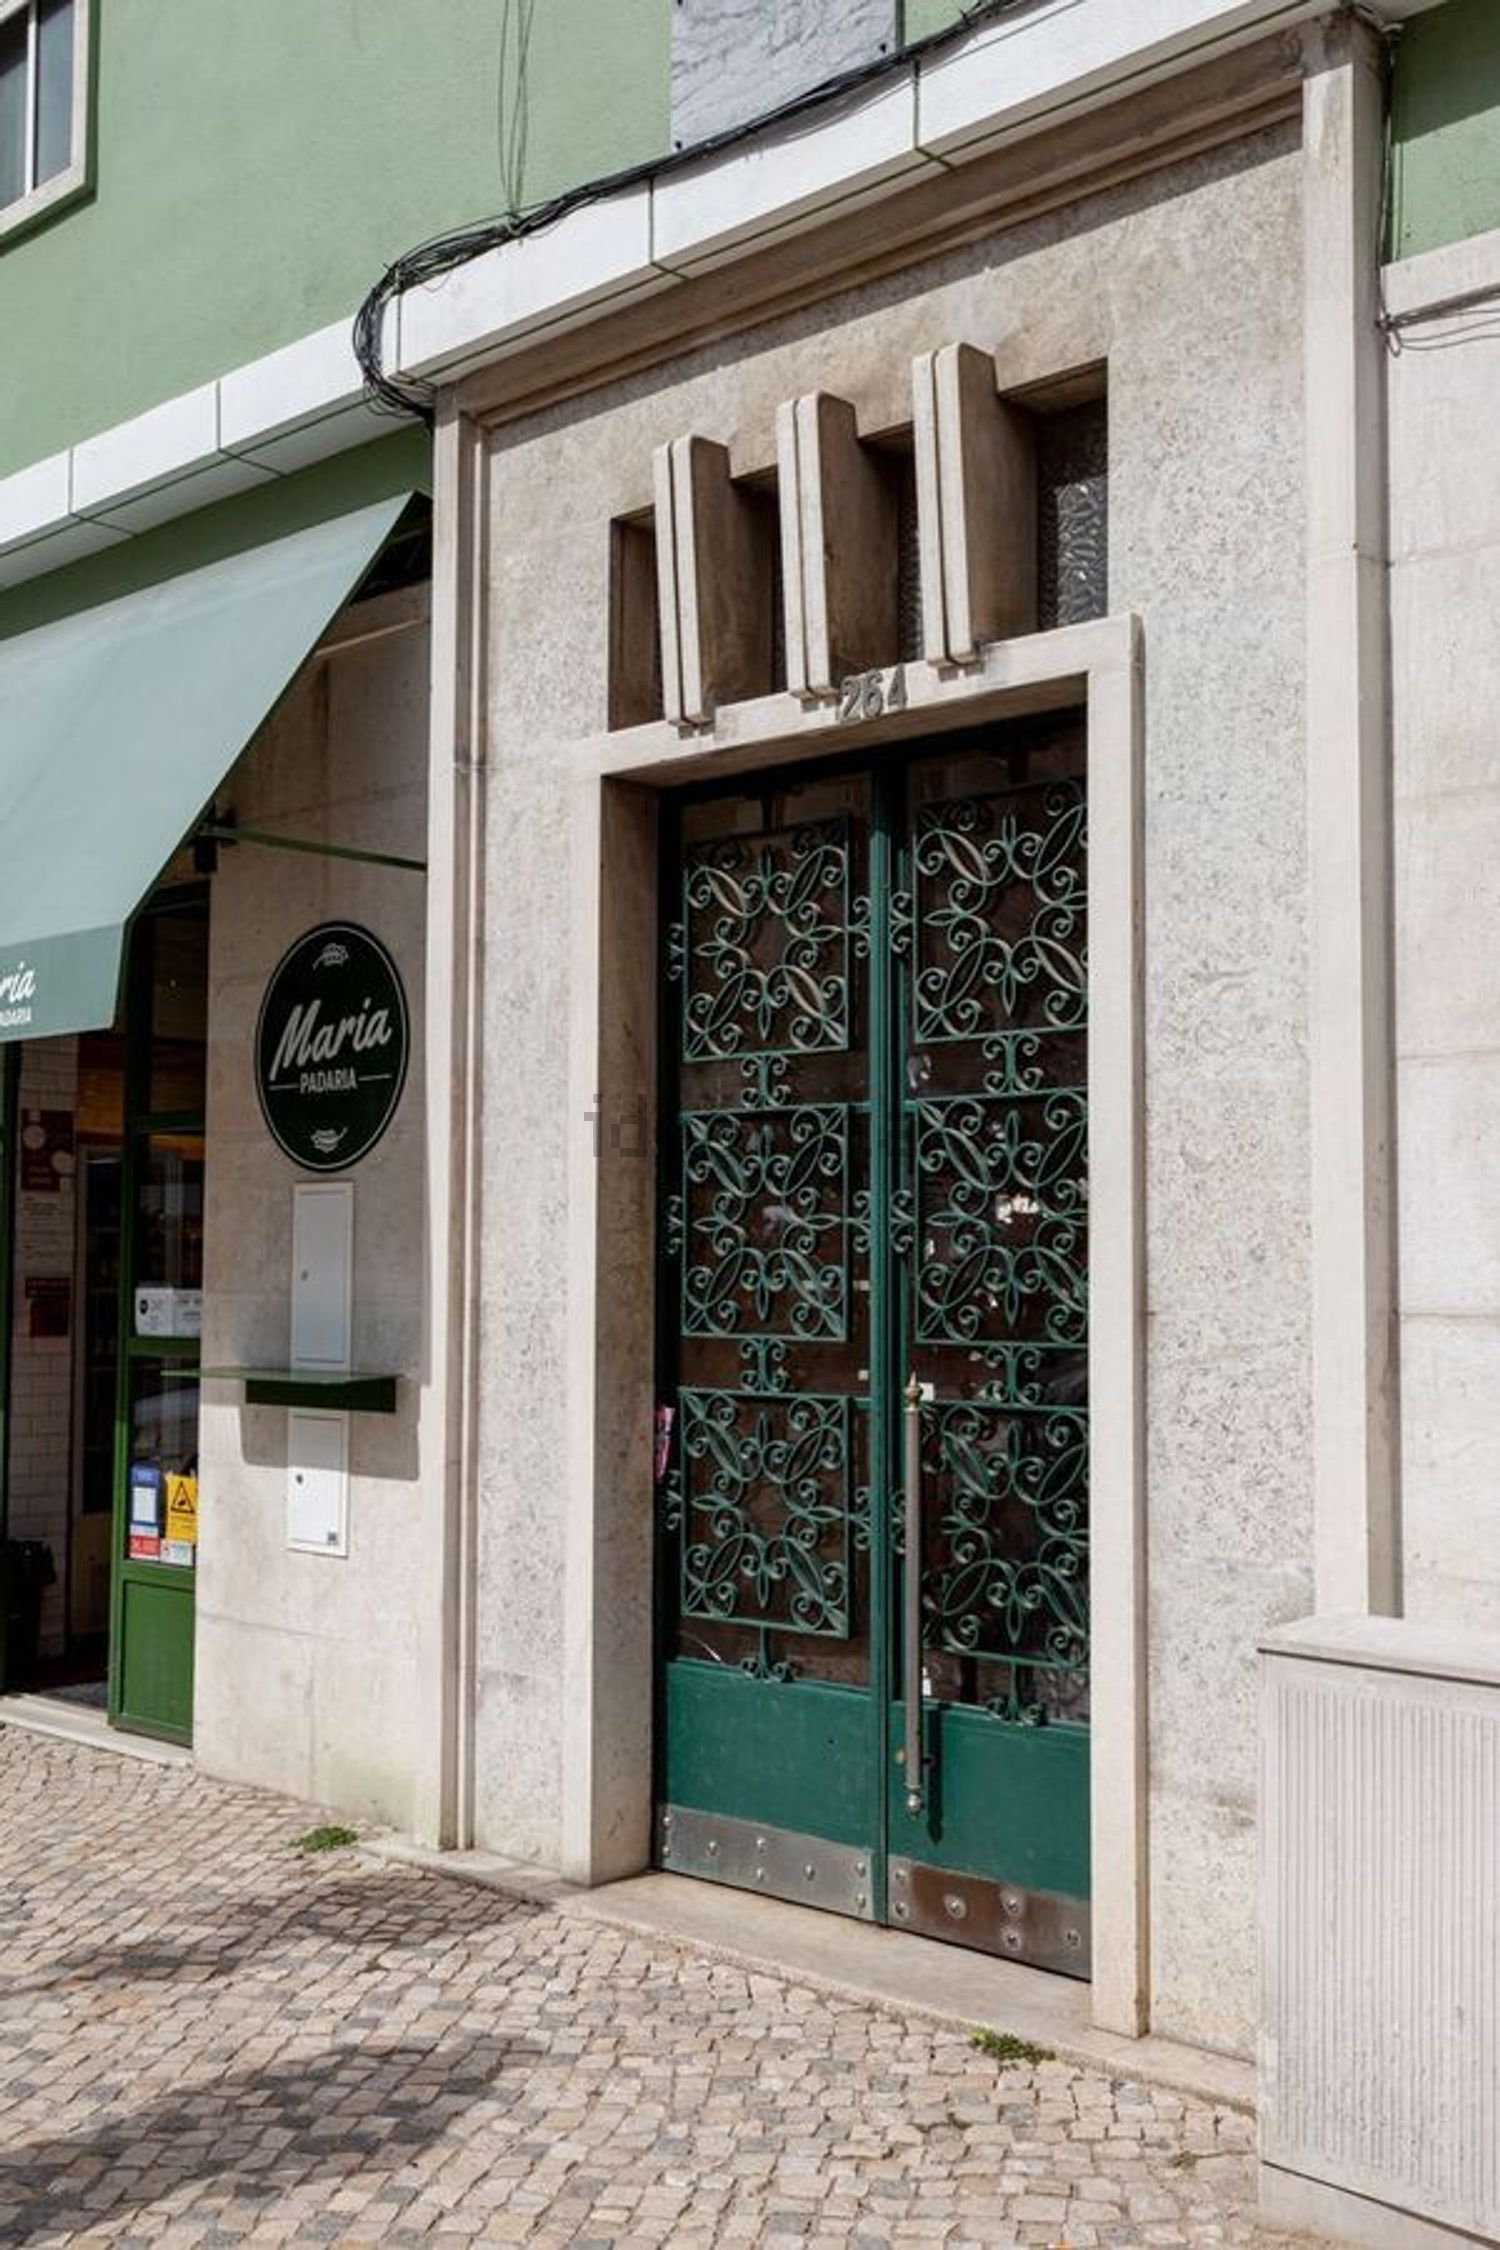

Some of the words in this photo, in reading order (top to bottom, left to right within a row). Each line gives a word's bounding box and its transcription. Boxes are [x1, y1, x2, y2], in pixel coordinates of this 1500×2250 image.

[839, 665, 908, 726] 264
[269, 997, 393, 1082] Maria
[300, 1067, 358, 1094] PADARIA
